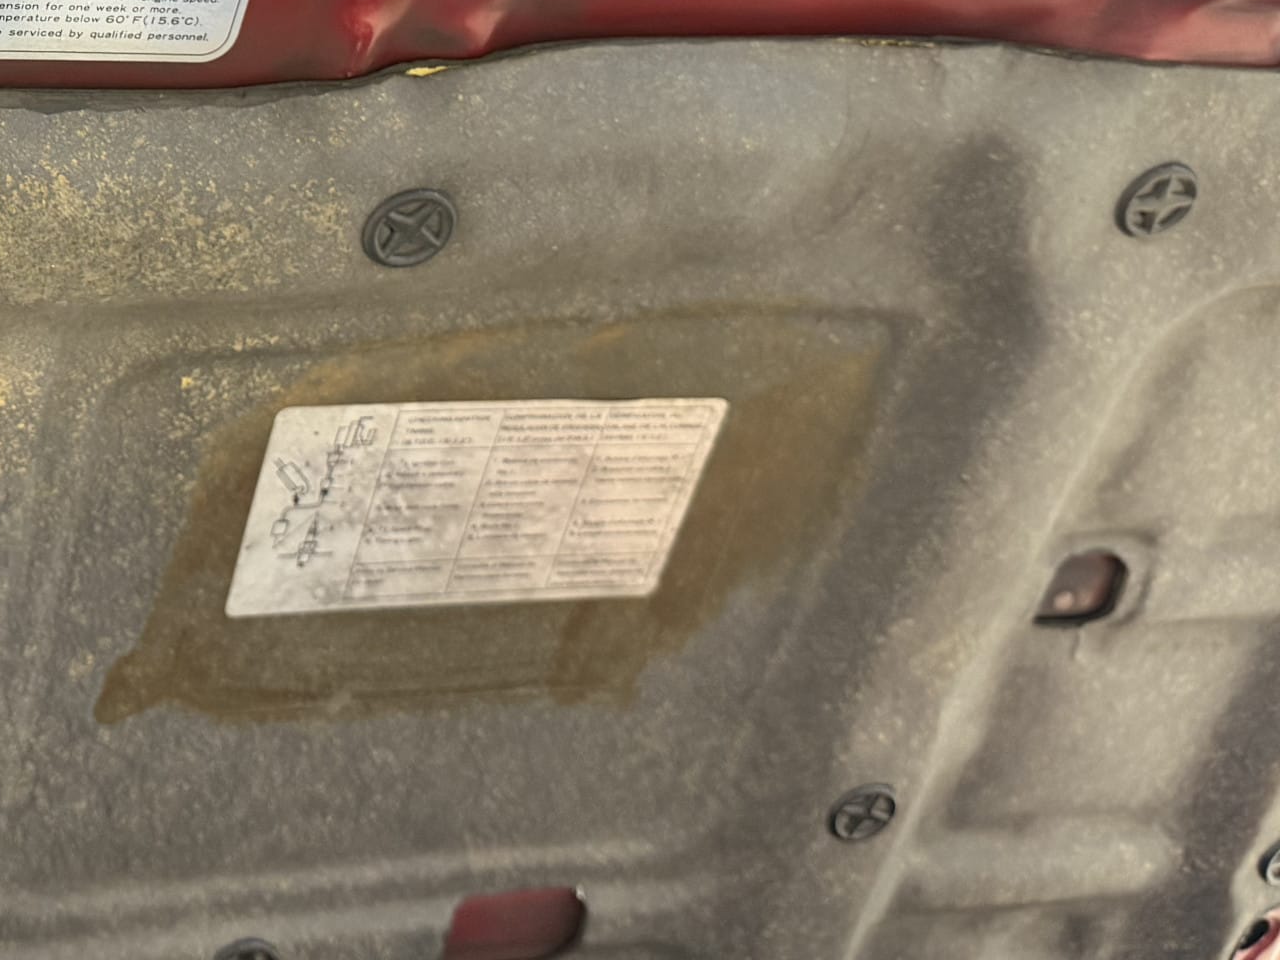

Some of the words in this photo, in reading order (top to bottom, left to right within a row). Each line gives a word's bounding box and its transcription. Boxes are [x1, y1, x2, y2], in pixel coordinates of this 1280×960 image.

[8, 28, 63, 38] serviced
[69, 30, 83, 39] by
[90, 30, 142, 41] qualified
[147, 33, 209, 42] personnel.
